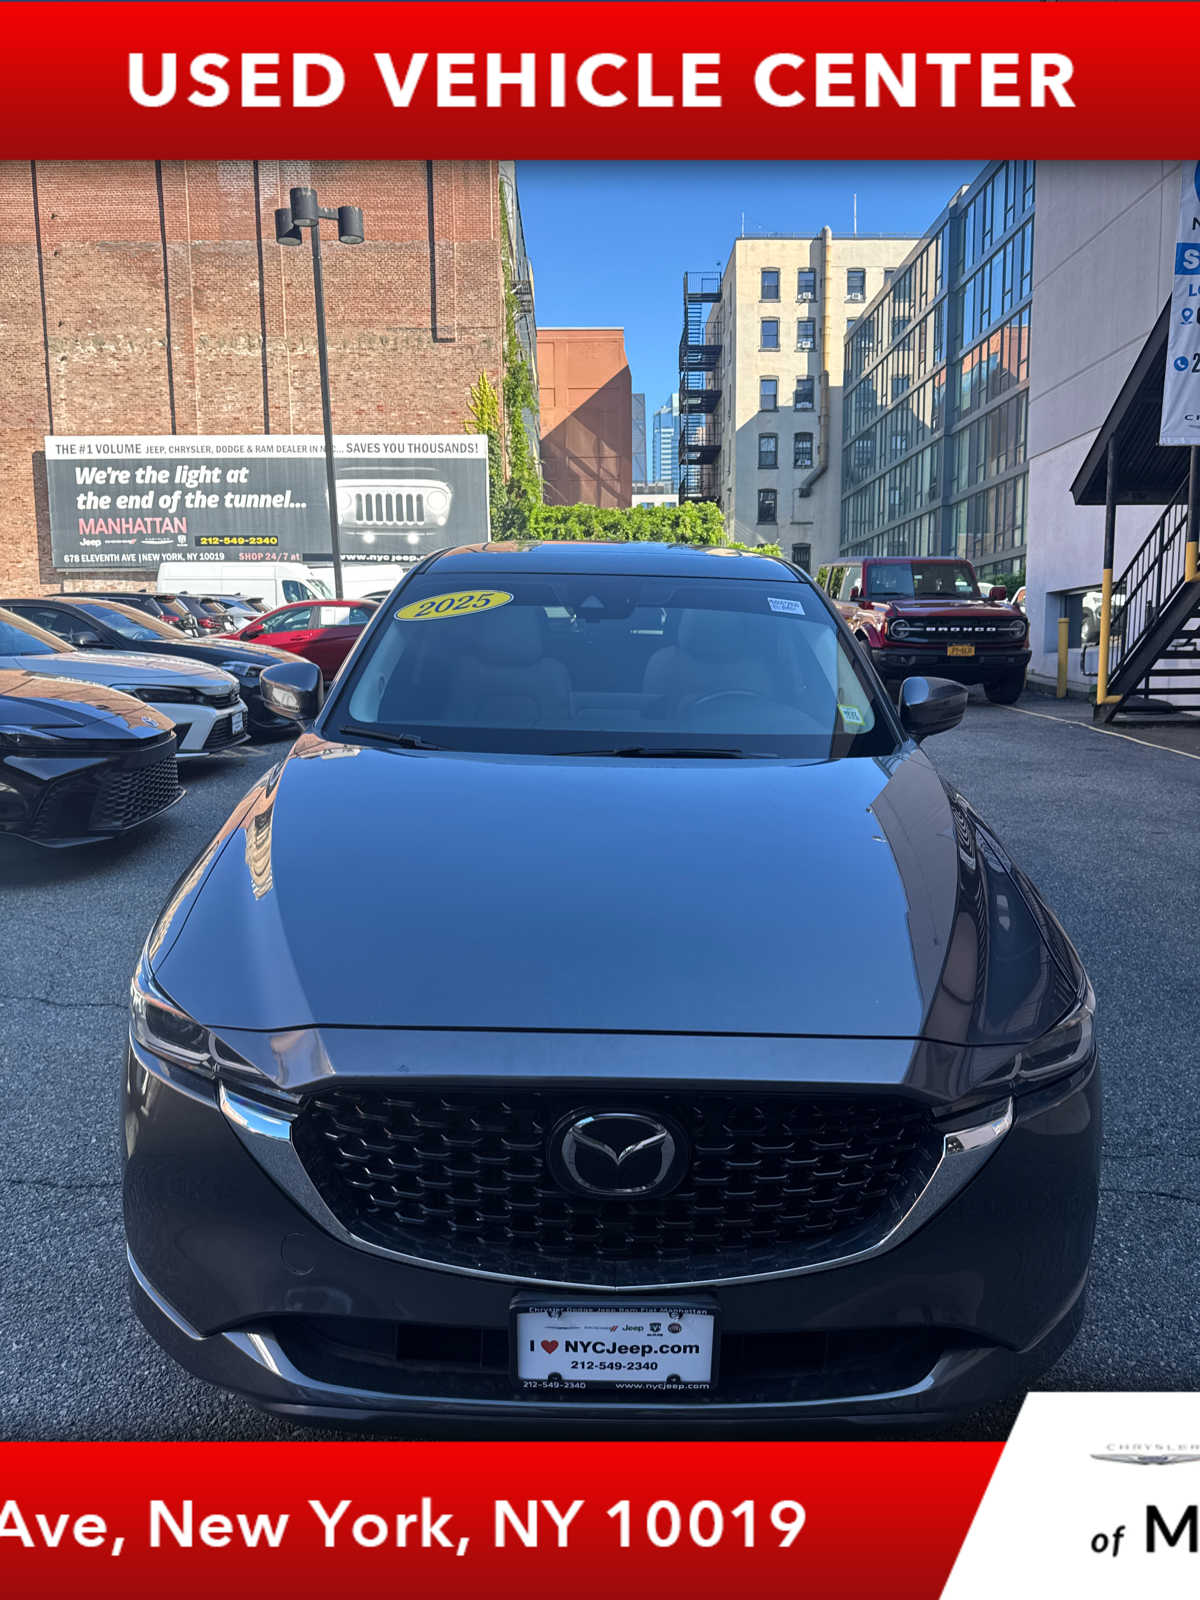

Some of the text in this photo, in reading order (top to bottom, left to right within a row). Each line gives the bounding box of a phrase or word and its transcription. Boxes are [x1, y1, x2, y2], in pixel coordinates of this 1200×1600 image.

[56, 442, 479, 455] THE #1 VOLUME JEEP, CHRYSLER, DODGE & RAM DEALER IN N... SAVES YOU THOUSANDS!
[75, 465, 249, 488] We're the light at
[76, 489, 308, 513] the end of the tunnel...
[78, 516, 188, 535] MANHATTAN
[80, 537, 102, 548] Jeep
[200, 536, 278, 545] 212-549-2340
[64, 554, 80, 563] 678
[81, 553, 120, 562] ELEVENTH
[121, 553, 137, 562] AVE
[186, 552, 198, 561] NY
[200, 552, 225, 561] 10019
[239, 552, 264, 561] SHOP
[265, 552, 289, 563] 24/7
[291, 552, 301, 561] at
[414, 593, 496, 618] 2025
[622, 1323, 645, 1333] Jeep
[530, 1340, 700, 1357] I NYCJeep.com
[570, 1360, 659, 1371] 212-549-2340
[523, 1380, 710, 1391] 212-549-2340 www.nycjeep.com
